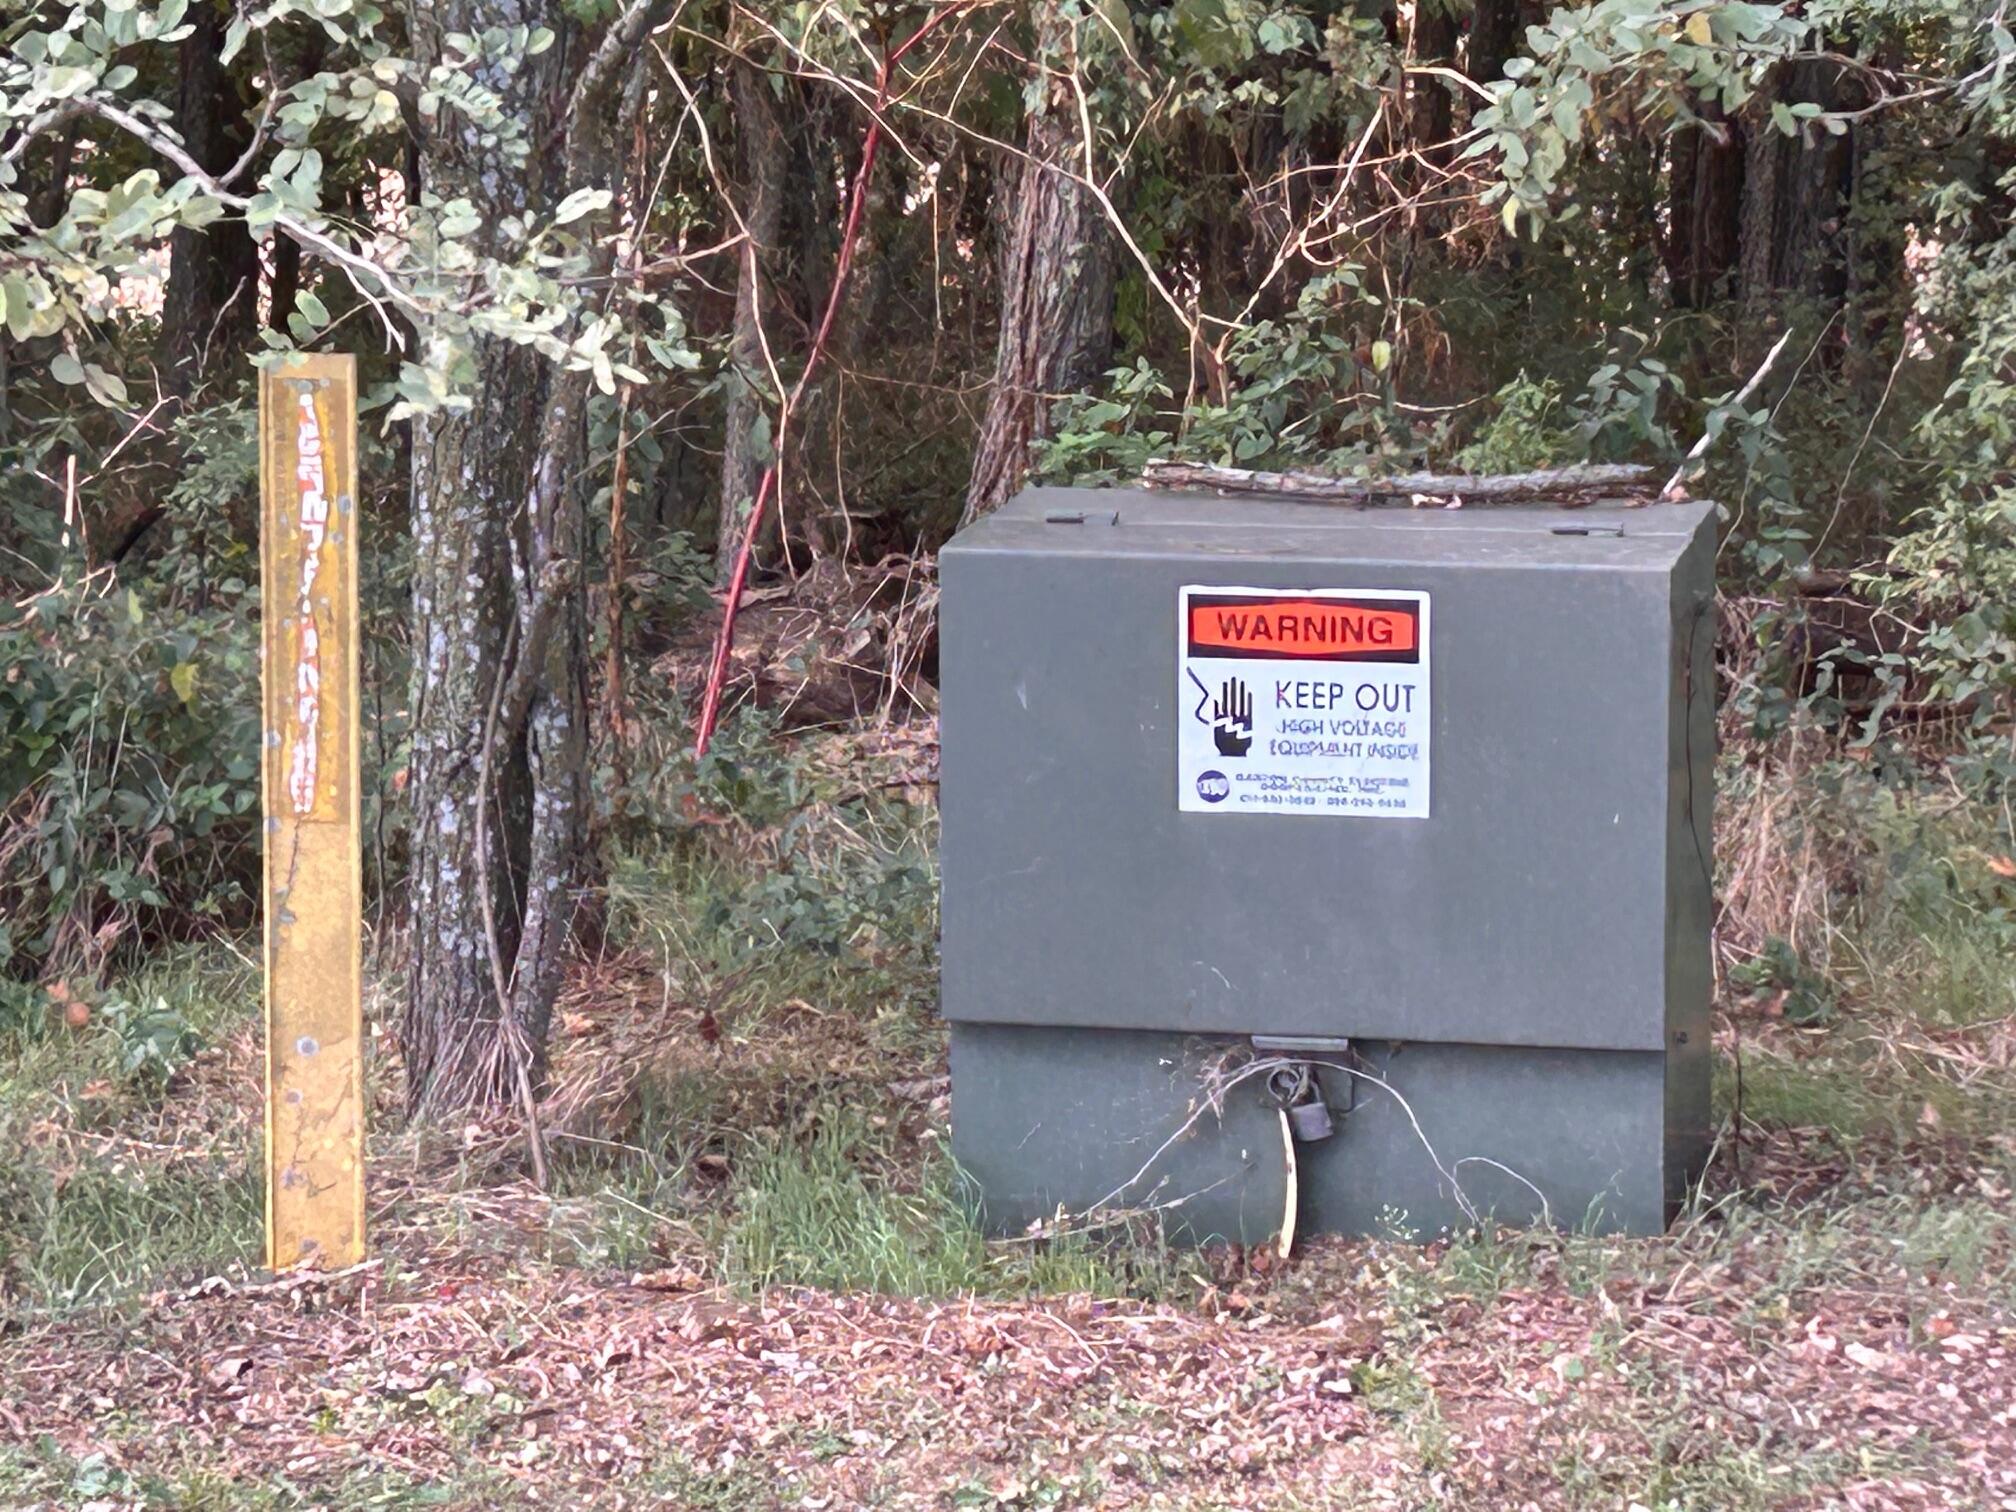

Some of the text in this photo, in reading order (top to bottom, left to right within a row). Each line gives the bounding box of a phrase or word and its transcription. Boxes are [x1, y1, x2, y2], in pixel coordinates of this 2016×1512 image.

[1217, 611, 1393, 645] WARNING
[1275, 680, 1416, 713] KEEP OUT
[1329, 720, 1406, 738] VOLTAGE
